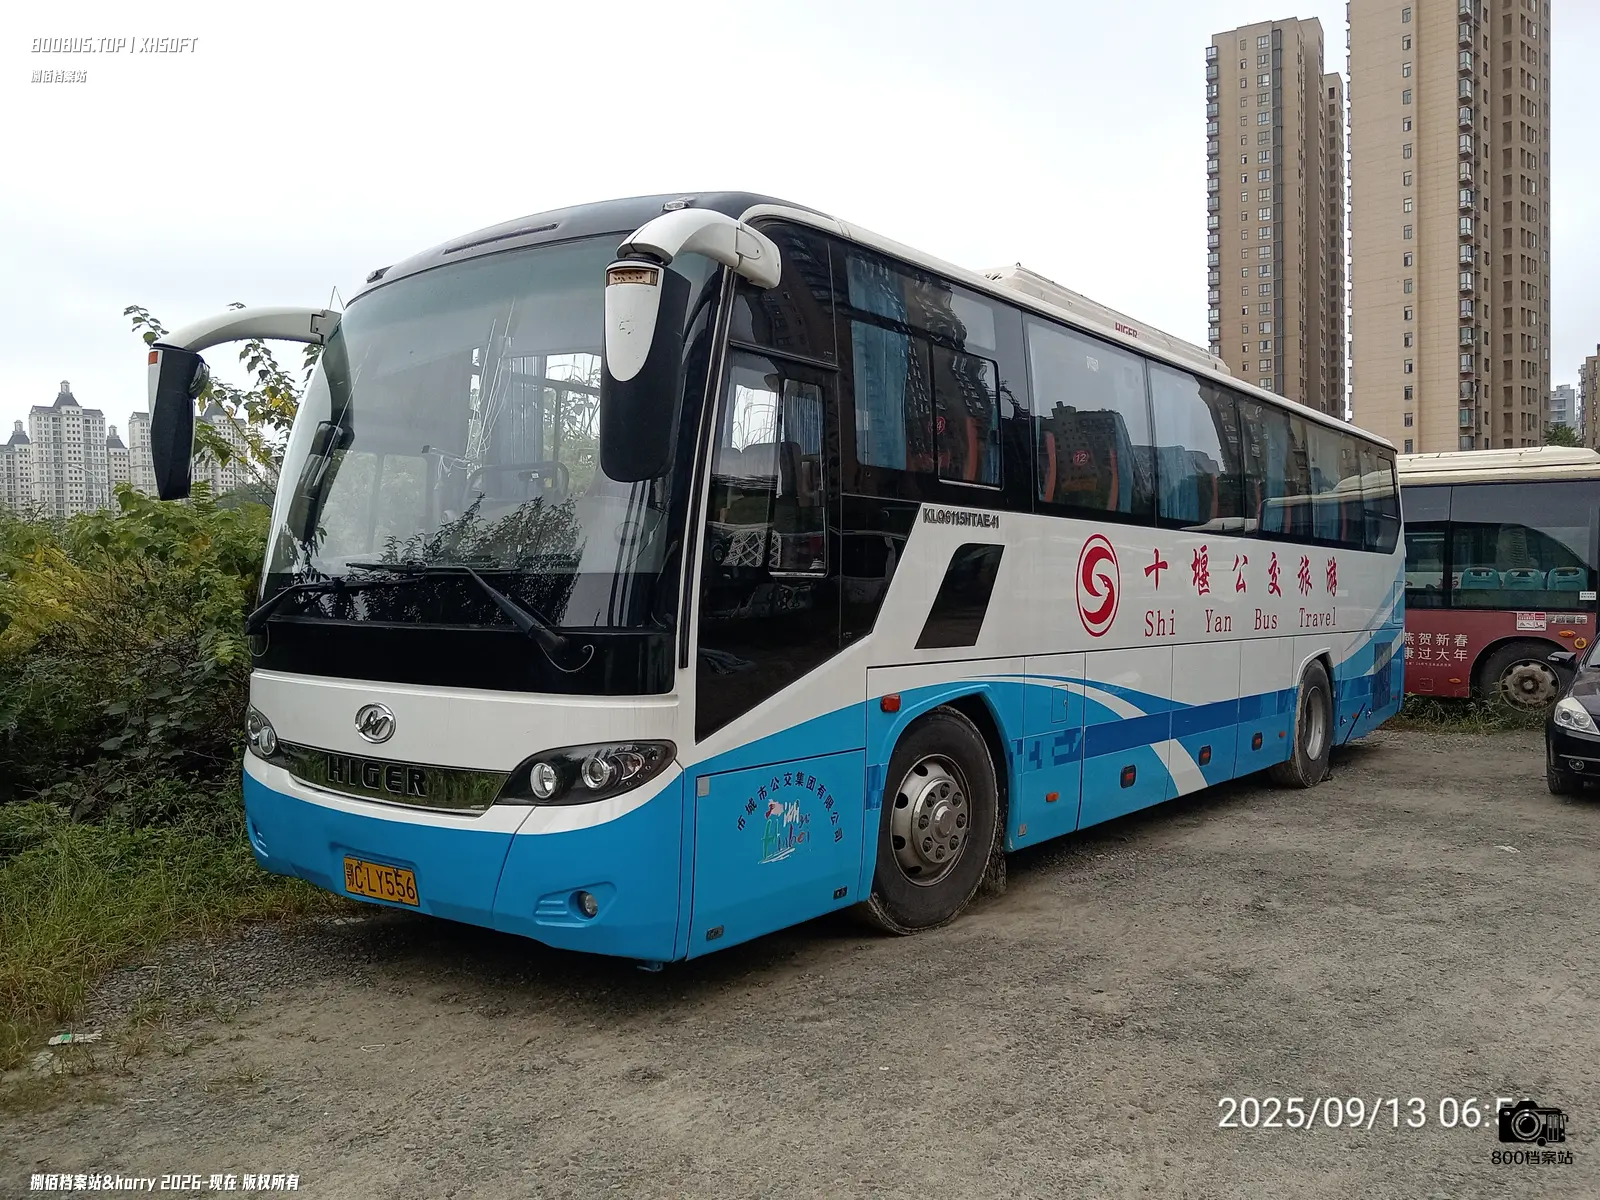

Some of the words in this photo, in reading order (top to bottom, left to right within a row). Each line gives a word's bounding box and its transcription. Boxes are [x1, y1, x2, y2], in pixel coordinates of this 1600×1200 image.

[1143, 545, 1338, 597] 十堰公交旅游
[1144, 610, 1176, 637] Shi
[1205, 609, 1232, 633] Yan
[1254, 608, 1278, 630] Bus
[1299, 607, 1337, 628] Travel
[327, 755, 427, 797] HIGER
